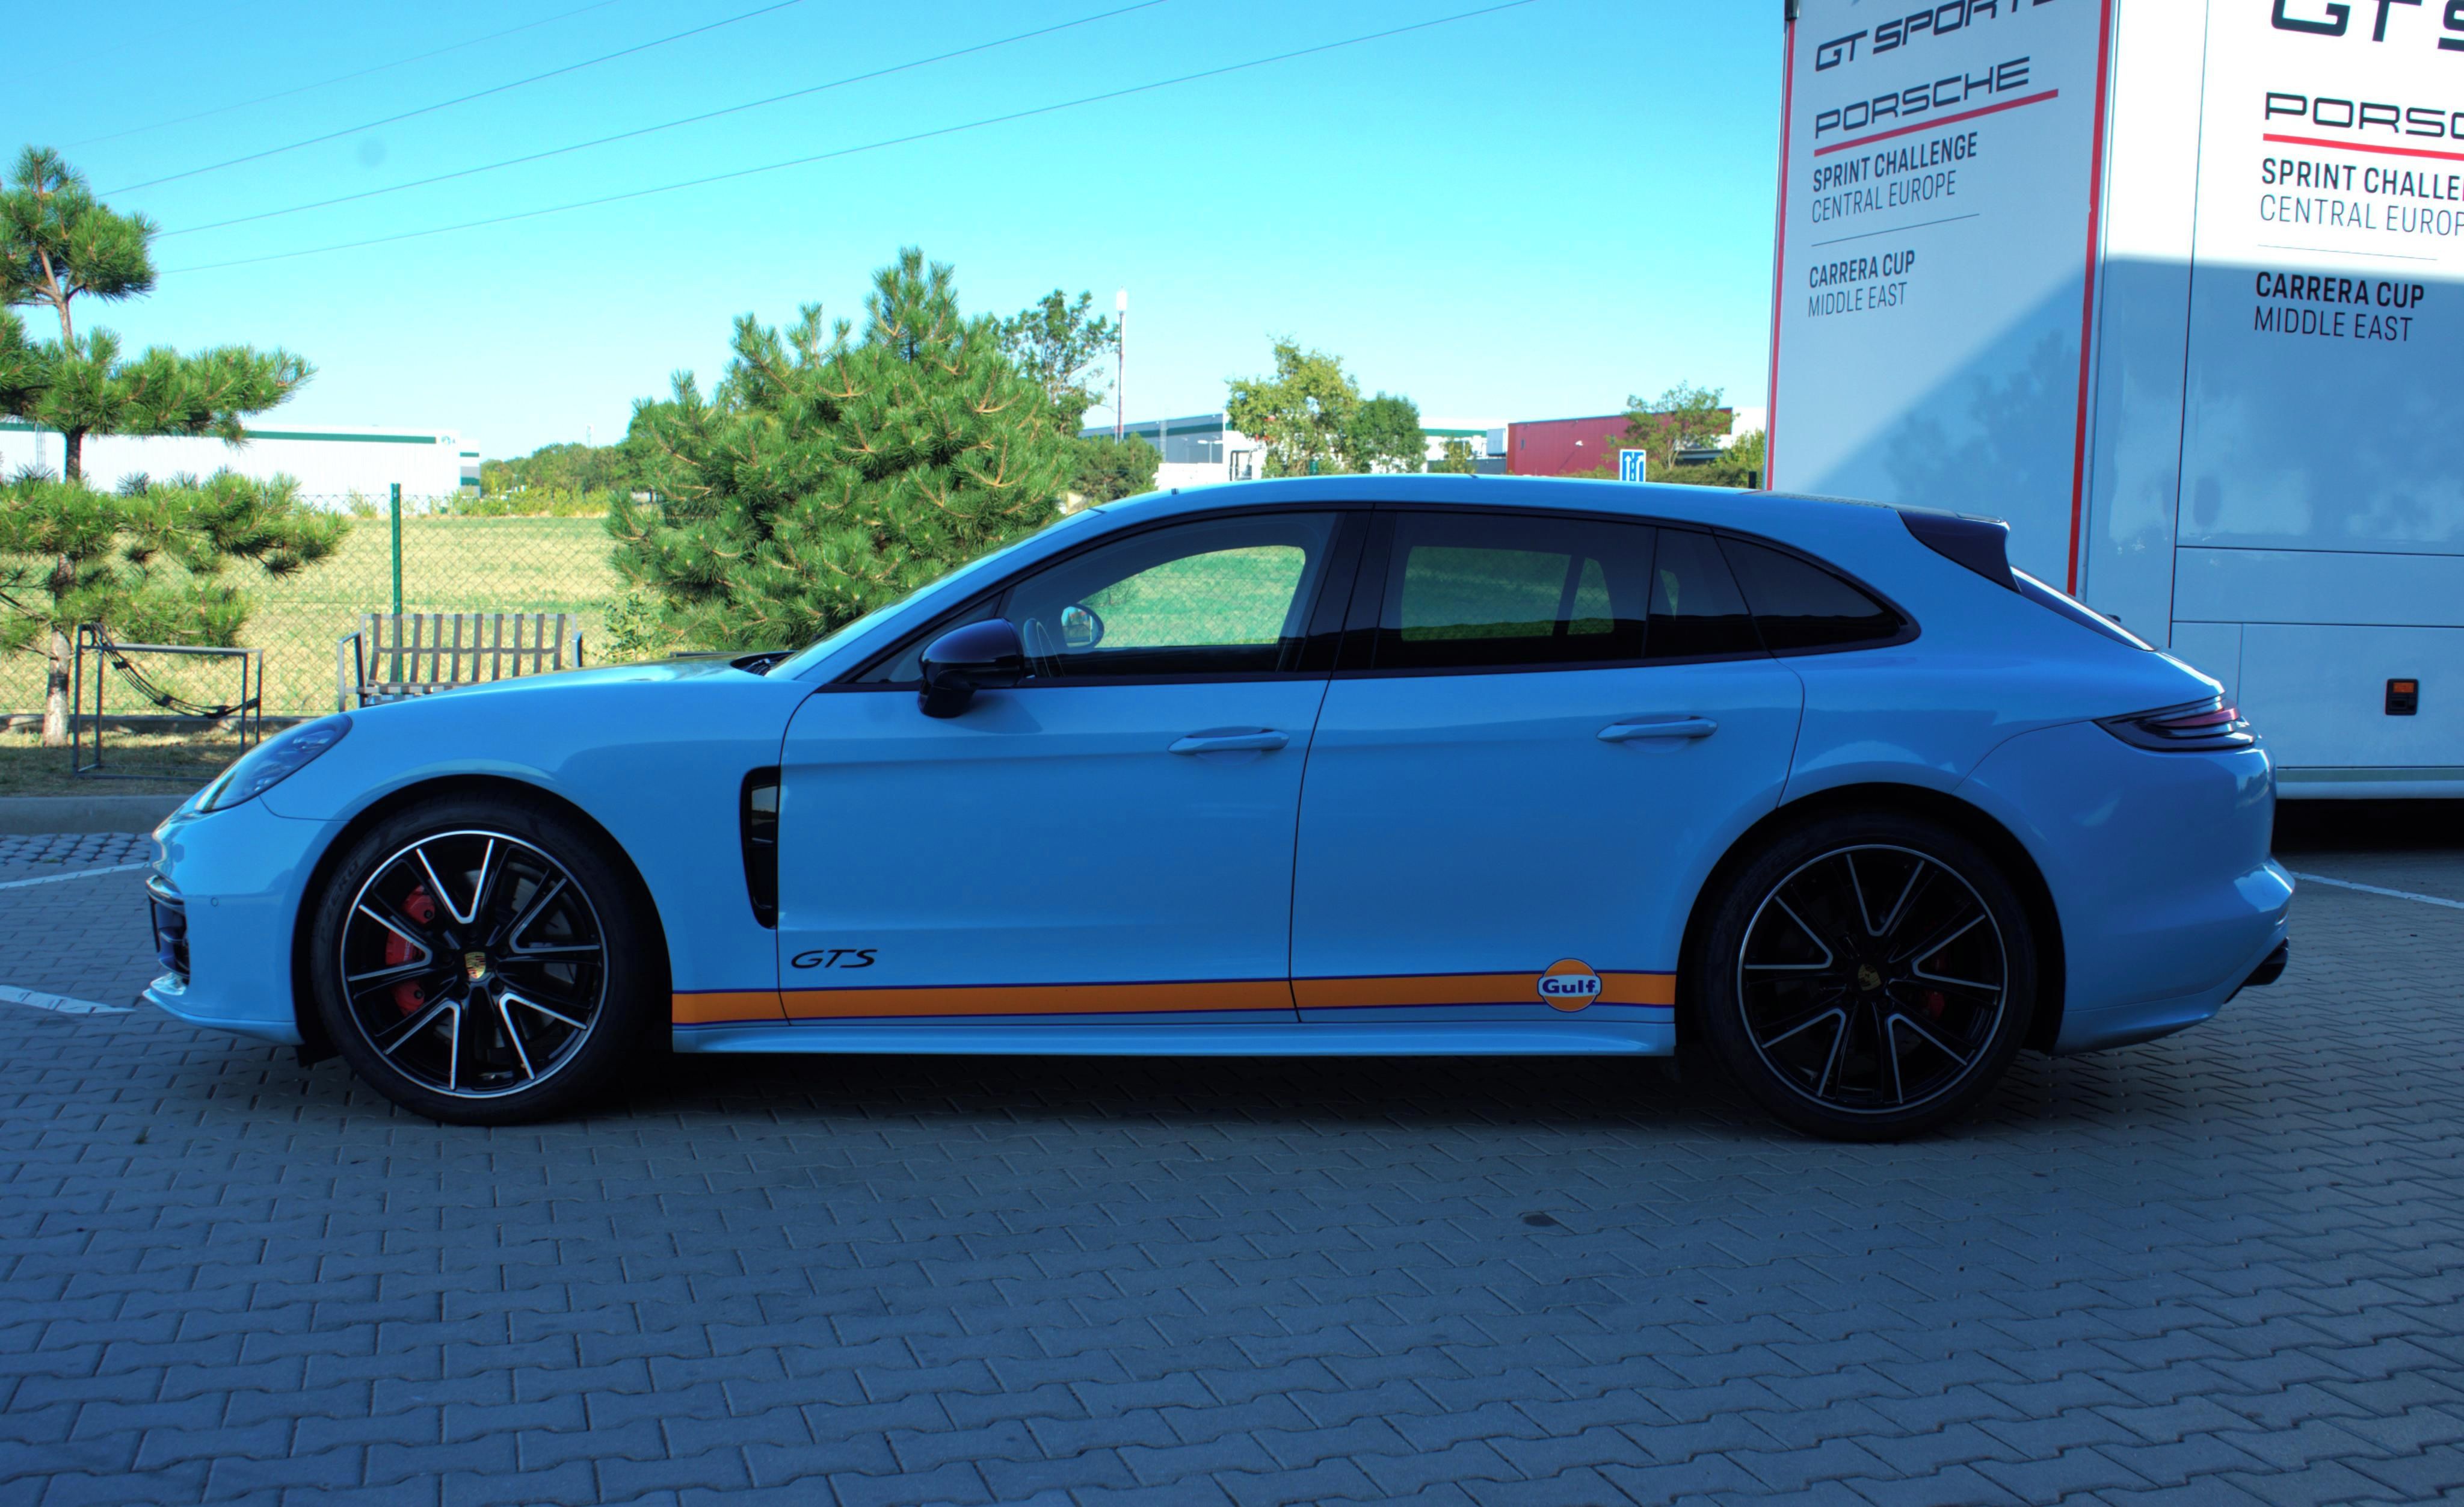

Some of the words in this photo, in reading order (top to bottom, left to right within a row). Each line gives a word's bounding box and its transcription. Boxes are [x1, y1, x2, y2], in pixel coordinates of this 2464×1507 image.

[1815, 29, 1868, 72] GT
[1873, 0, 2056, 54] SPOR
[2272, 0, 2422, 43] GT
[1815, 56, 2030, 139] PORSCHE
[1813, 156, 1870, 193] SPRINT
[1874, 131, 1977, 178] CHALLENGE
[2262, 158, 2356, 191] SPRINT
[2364, 167, 2464, 202] CHALLE
[1812, 186, 1883, 223] CENTRAL
[1889, 170, 1956, 208] EUROPE
[2260, 194, 2376, 229] CENTRAL
[1809, 256, 1878, 288] CARRERA
[1882, 250, 1915, 277] CUP
[1808, 288, 1863, 318] MIDDLE
[1868, 281, 1908, 309] EAST
[2256, 271, 2369, 305] CARRERA
[2376, 282, 2424, 309] CUP
[2254, 306, 2345, 337] MIDDLE
[2354, 313, 2413, 342] EAST
[791, 949, 878, 969] GTS
[1542, 978, 1596, 994] Gulf
